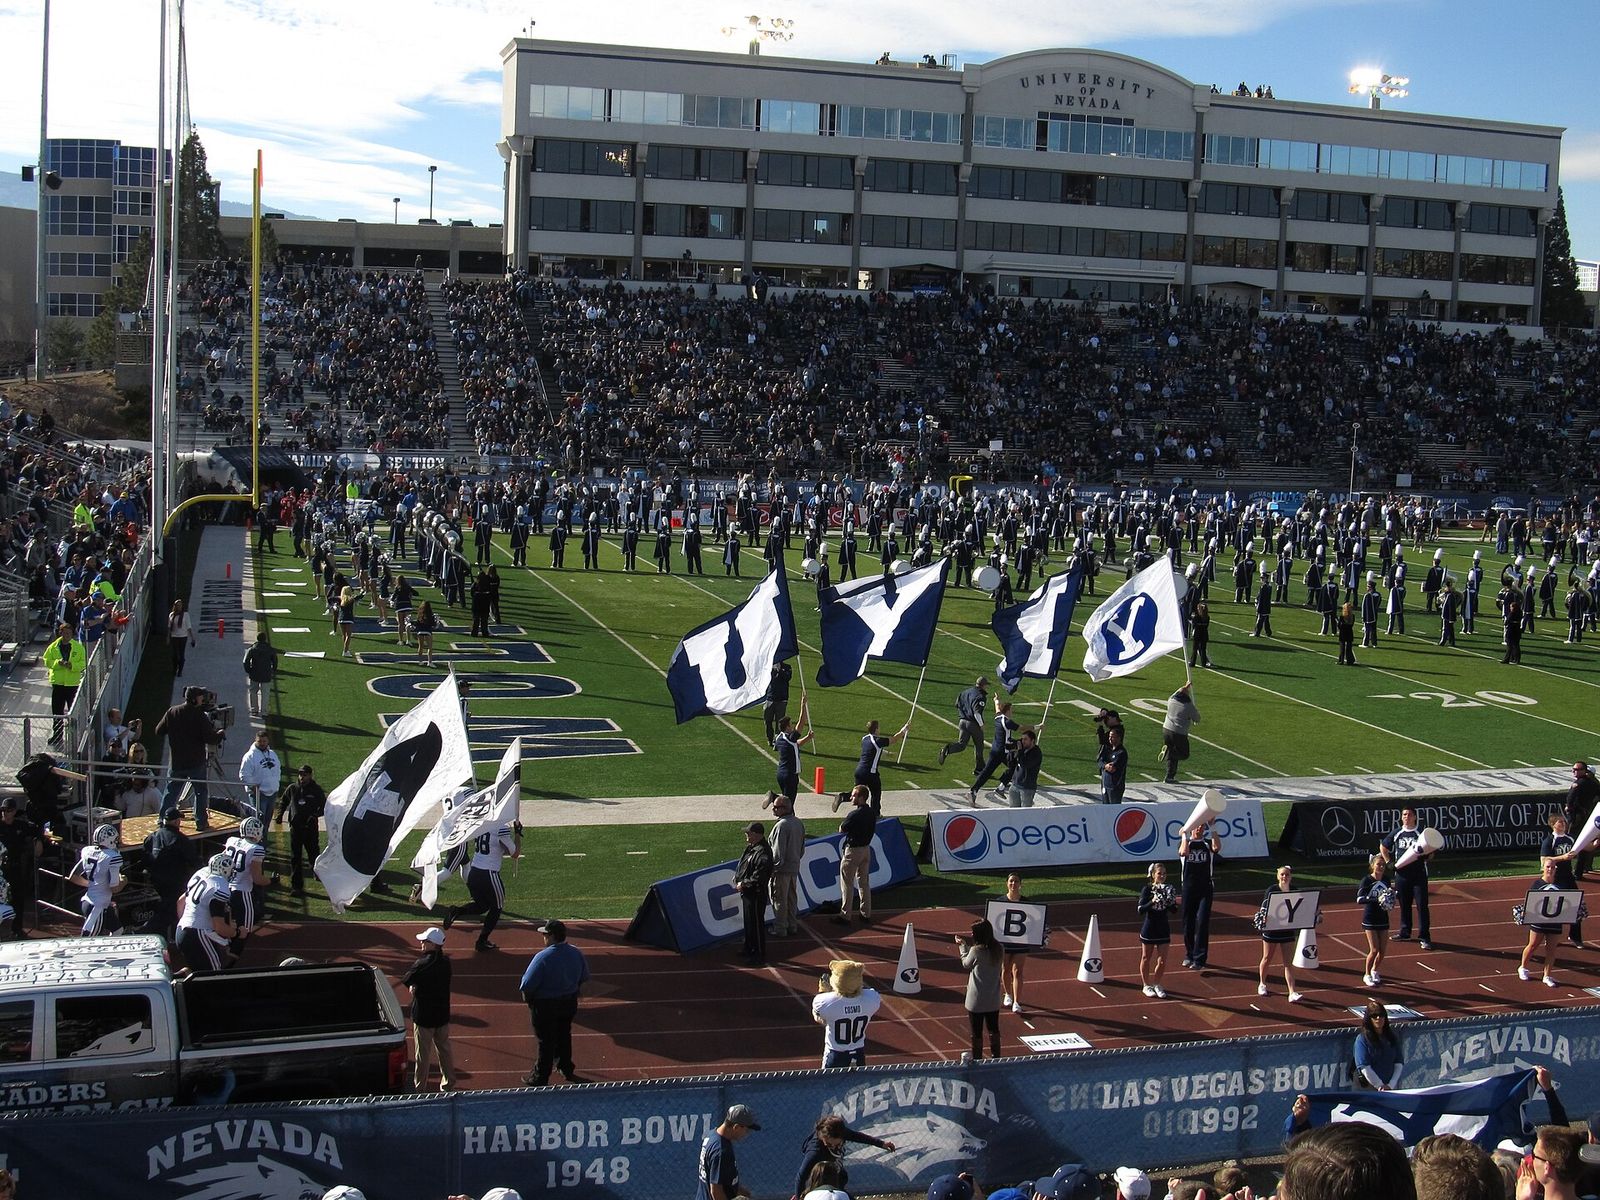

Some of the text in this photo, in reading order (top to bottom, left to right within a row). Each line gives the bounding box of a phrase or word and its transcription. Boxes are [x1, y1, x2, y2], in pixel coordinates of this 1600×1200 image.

[1021, 73, 1155, 98] UNIVERSITY
[1080, 87, 1096, 95] OF
[1055, 95, 1120, 110] NEVADA
[386, 456, 444, 469] SECTION
[1248, 491, 1271, 500] NEVAD
[1409, 690, 1538, 708] 20
[1363, 803, 1505, 834] MEREDES-BENZ
[1509, 803, 1532, 826] OF
[999, 817, 1089, 853] pepsi
[1487, 832, 1512, 848] AND
[1188, 851, 1207, 863] BYU
[1316, 847, 1369, 856] Mercedes-Benz
[88, 857, 99, 881] 7
[1284, 898, 1304, 923] Y
[1541, 896, 1565, 918] U
[1004, 909, 1027, 937] B
[844, 1005, 861, 1014] COSMO
[834, 1016, 868, 1044] 00
[1027, 1036, 1084, 1047] DEFENSE
[1439, 1026, 1571, 1080] NEVADA
[1102, 1079, 1162, 1109] LAS
[1171, 1068, 1265, 1104] VEGAS
[1273, 1062, 1353, 1093] BOWL
[832, 1077, 1000, 1124] NEVADA
[1190, 1104, 1259, 1135] 1992
[463, 1112, 713, 1154] HARBOR BOWL
[146, 1119, 344, 1181] NEVADA
[546, 1156, 631, 1189] 1948
